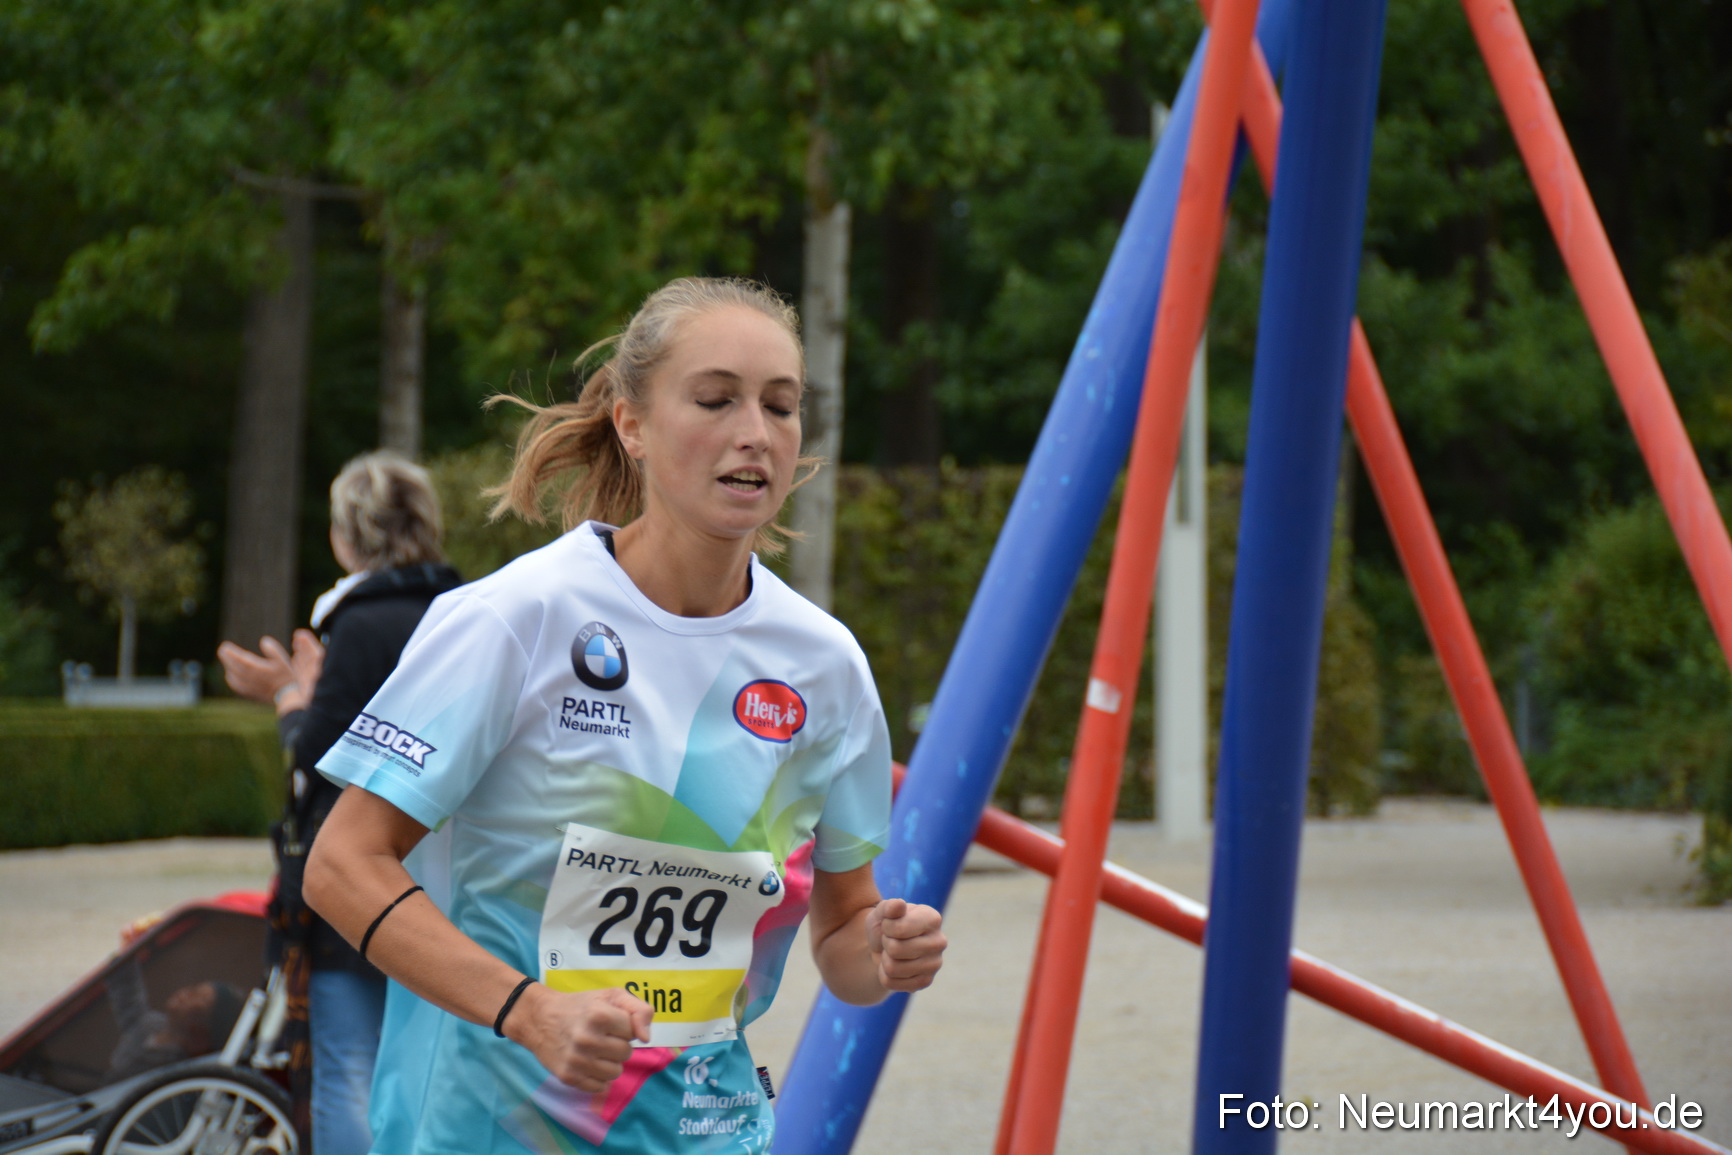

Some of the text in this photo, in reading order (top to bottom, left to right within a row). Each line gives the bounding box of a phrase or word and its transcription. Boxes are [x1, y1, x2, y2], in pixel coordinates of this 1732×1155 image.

[561, 696, 632, 725] PARTL
[744, 692, 798, 728] Hervis
[347, 712, 437, 769] BOCK
[559, 715, 631, 739] Neumarkt
[566, 847, 753, 890] PARTL Neumarkt
[588, 886, 728, 959] 269
[550, 952, 558, 967] B
[682, 1090, 760, 1109] Neumarkte
[678, 1114, 747, 1135] Stadtlauf
